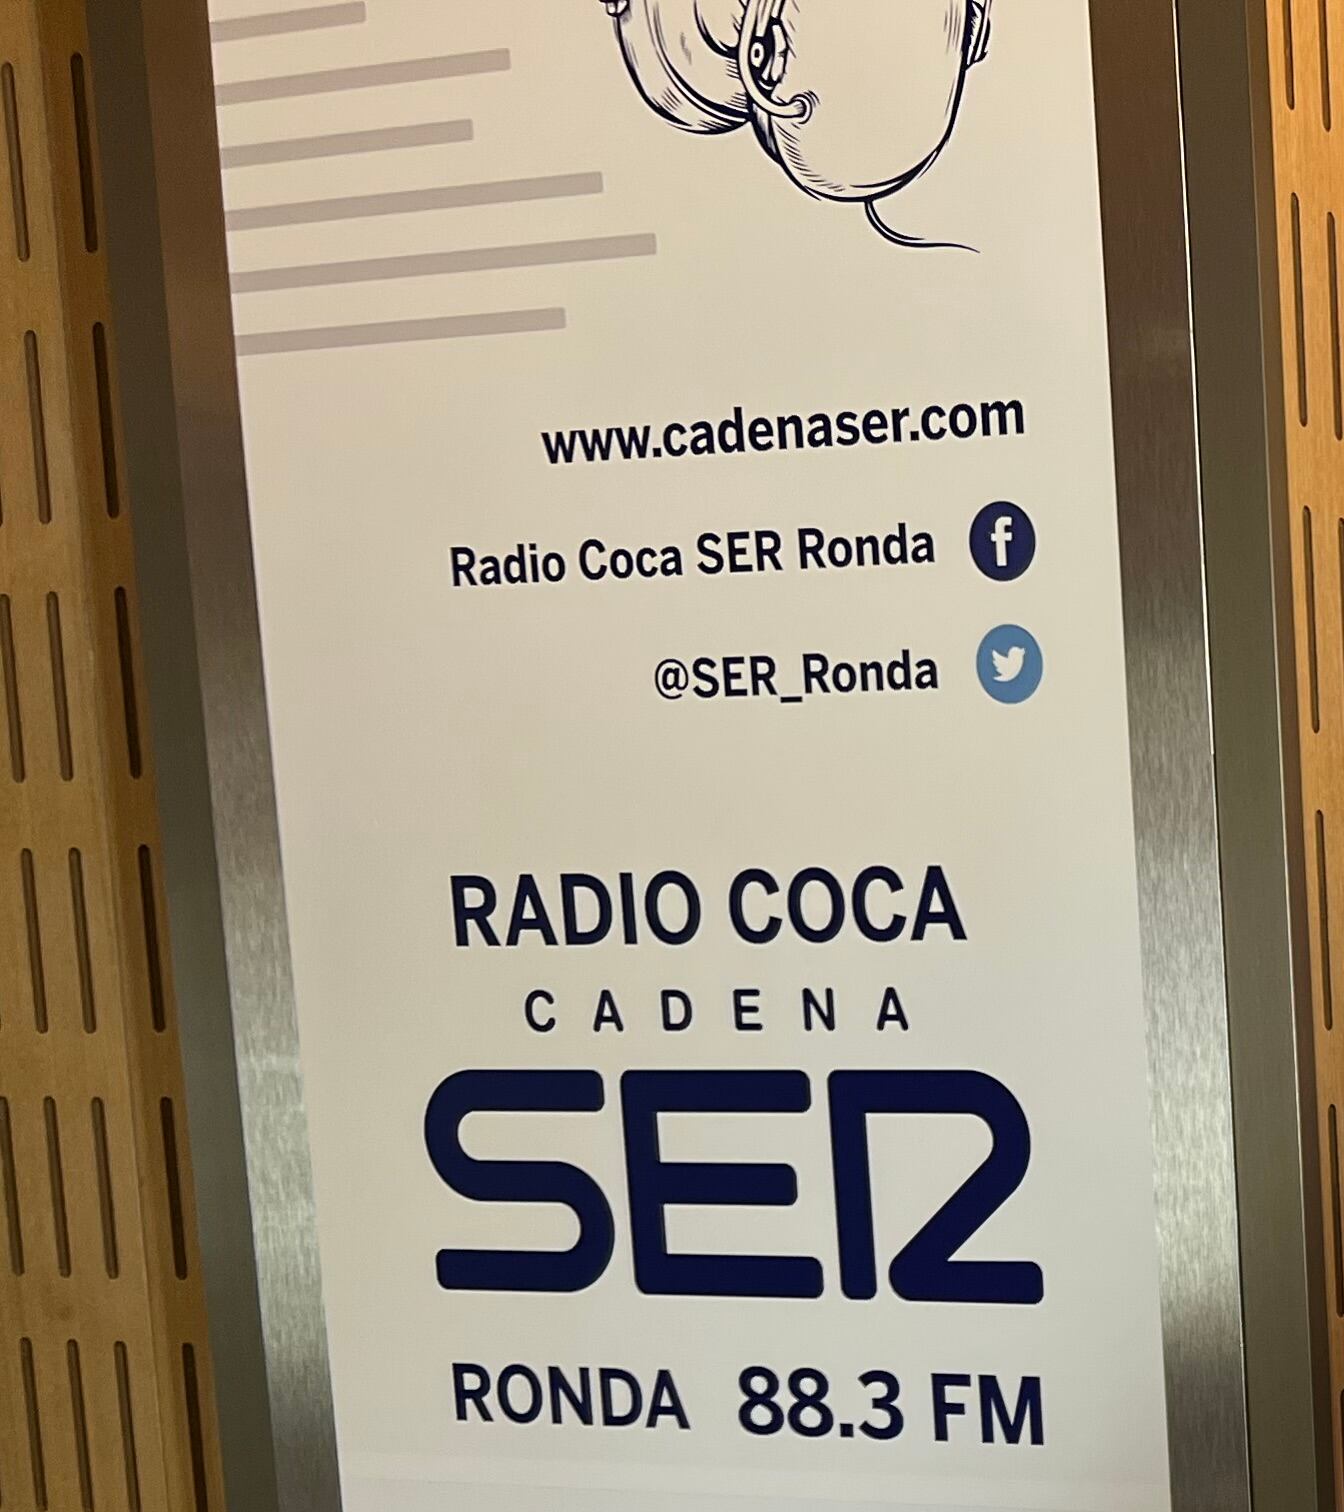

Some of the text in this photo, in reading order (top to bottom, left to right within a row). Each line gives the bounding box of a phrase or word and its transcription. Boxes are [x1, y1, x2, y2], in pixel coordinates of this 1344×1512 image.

[541, 399, 1025, 464] www.cadenaser.com
[450, 522, 935, 587] Radio Coca SER Ronda
[654, 649, 939, 704] @SER_Ronda
[450, 865, 968, 947] RADIO COCA
[524, 986, 909, 1033] CADENA
[423, 1069, 1044, 1304] SER
[452, 1362, 1044, 1446] RONDA 88.3 FM
